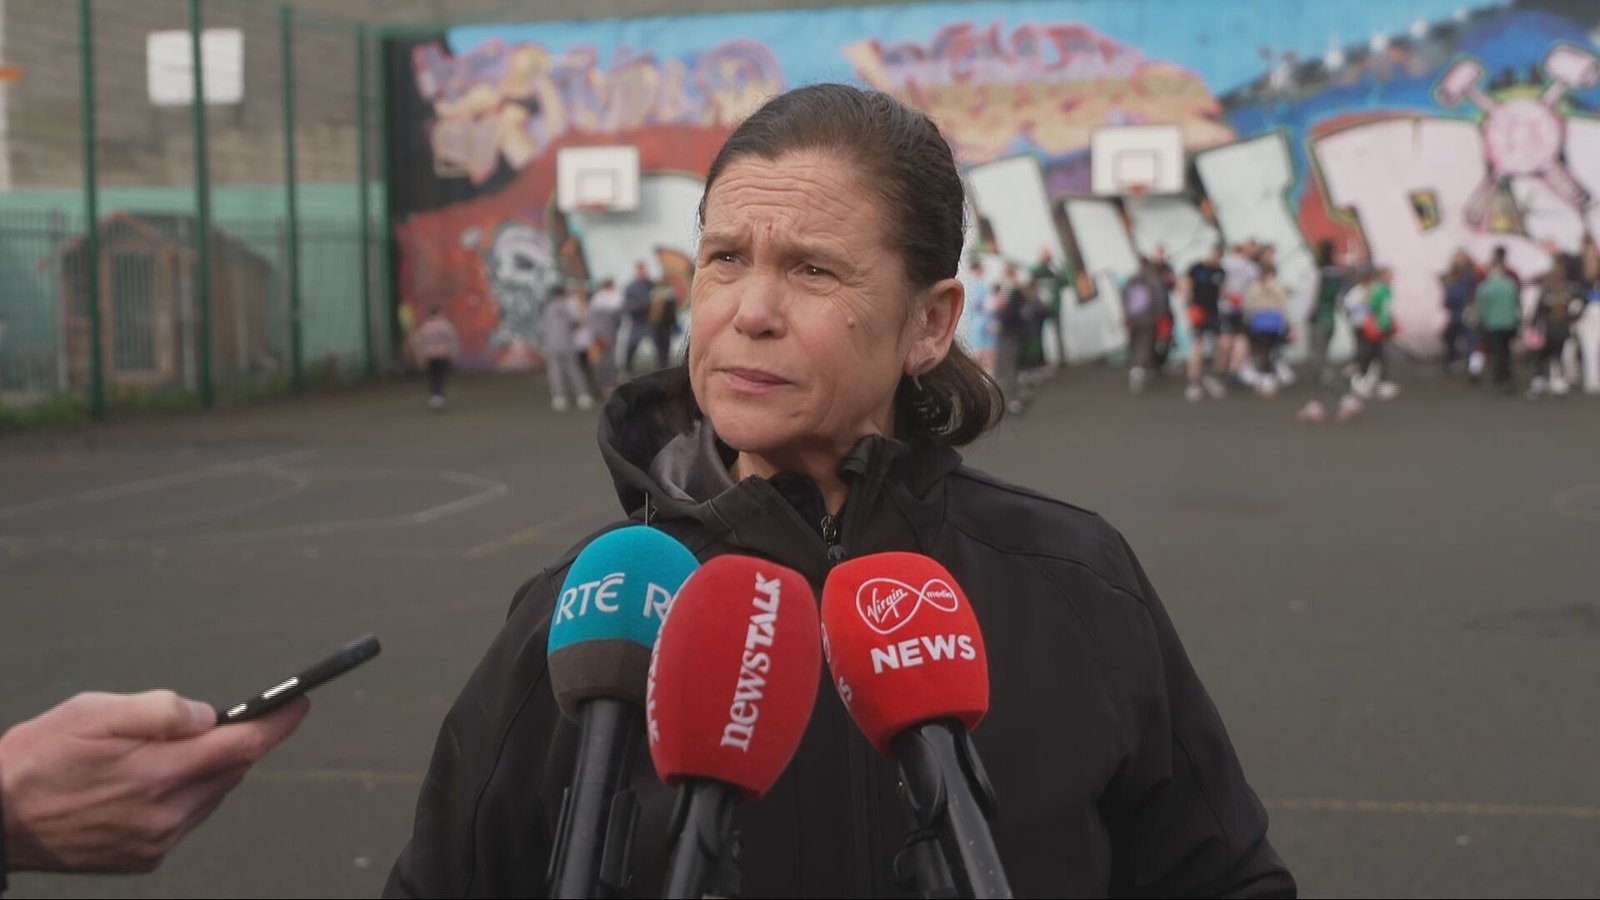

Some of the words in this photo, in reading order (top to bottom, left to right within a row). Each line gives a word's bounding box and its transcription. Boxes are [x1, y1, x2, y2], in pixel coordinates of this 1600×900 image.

[556, 572, 625, 625] RTÉ
[867, 588, 908, 623] Virgin
[926, 590, 954, 599] media
[870, 634, 976, 674] NEWS
